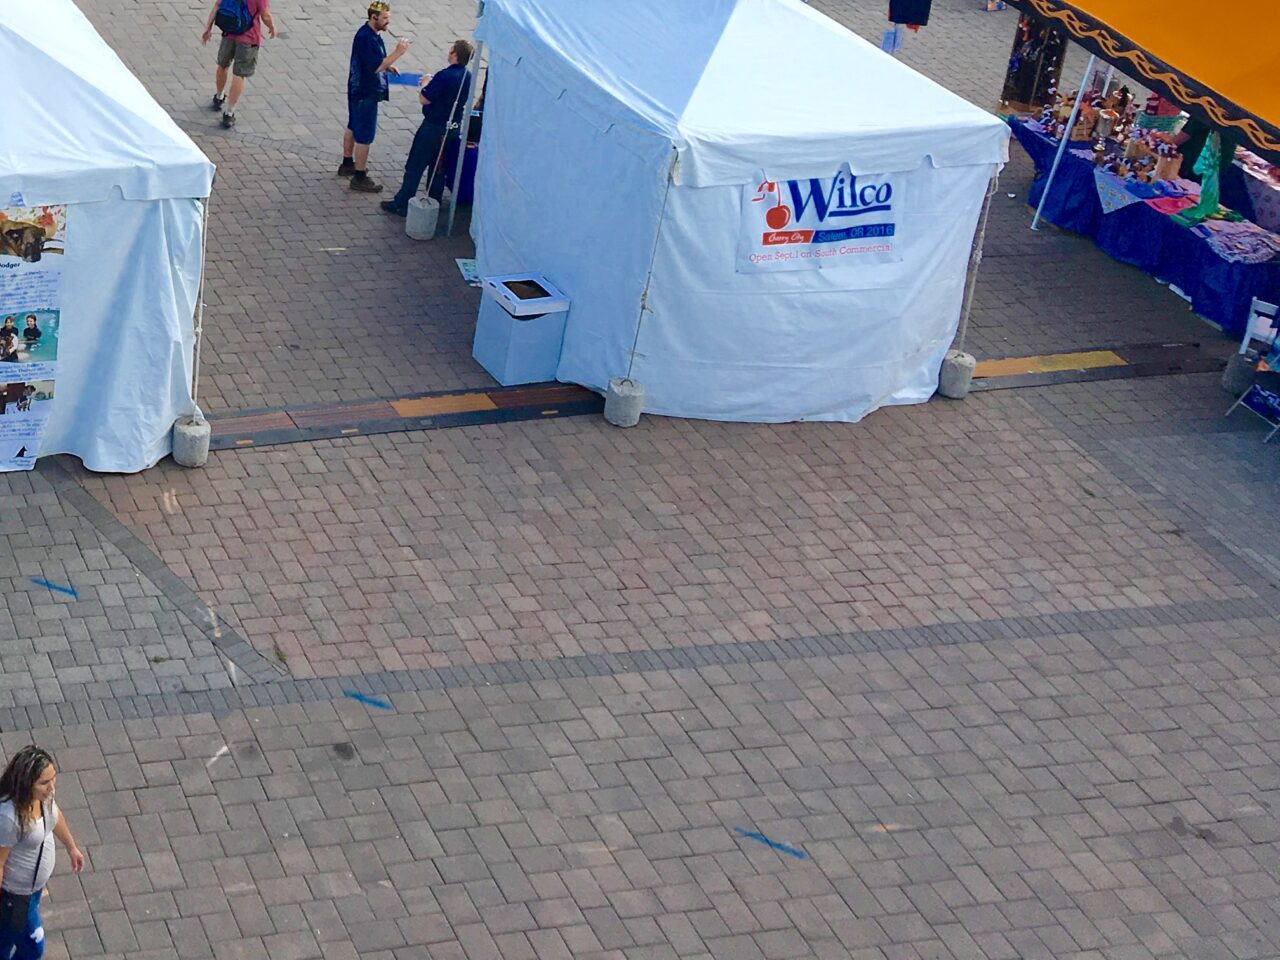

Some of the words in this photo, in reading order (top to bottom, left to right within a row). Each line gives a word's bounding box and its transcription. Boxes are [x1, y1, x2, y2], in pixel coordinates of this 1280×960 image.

[786, 170, 893, 223] Wilco
[851, 227, 864, 238] OR
[866, 225, 894, 237] 2016
[749, 252, 773, 263] Open
[815, 247, 837, 258] South
[839, 243, 894, 255] Commercial
